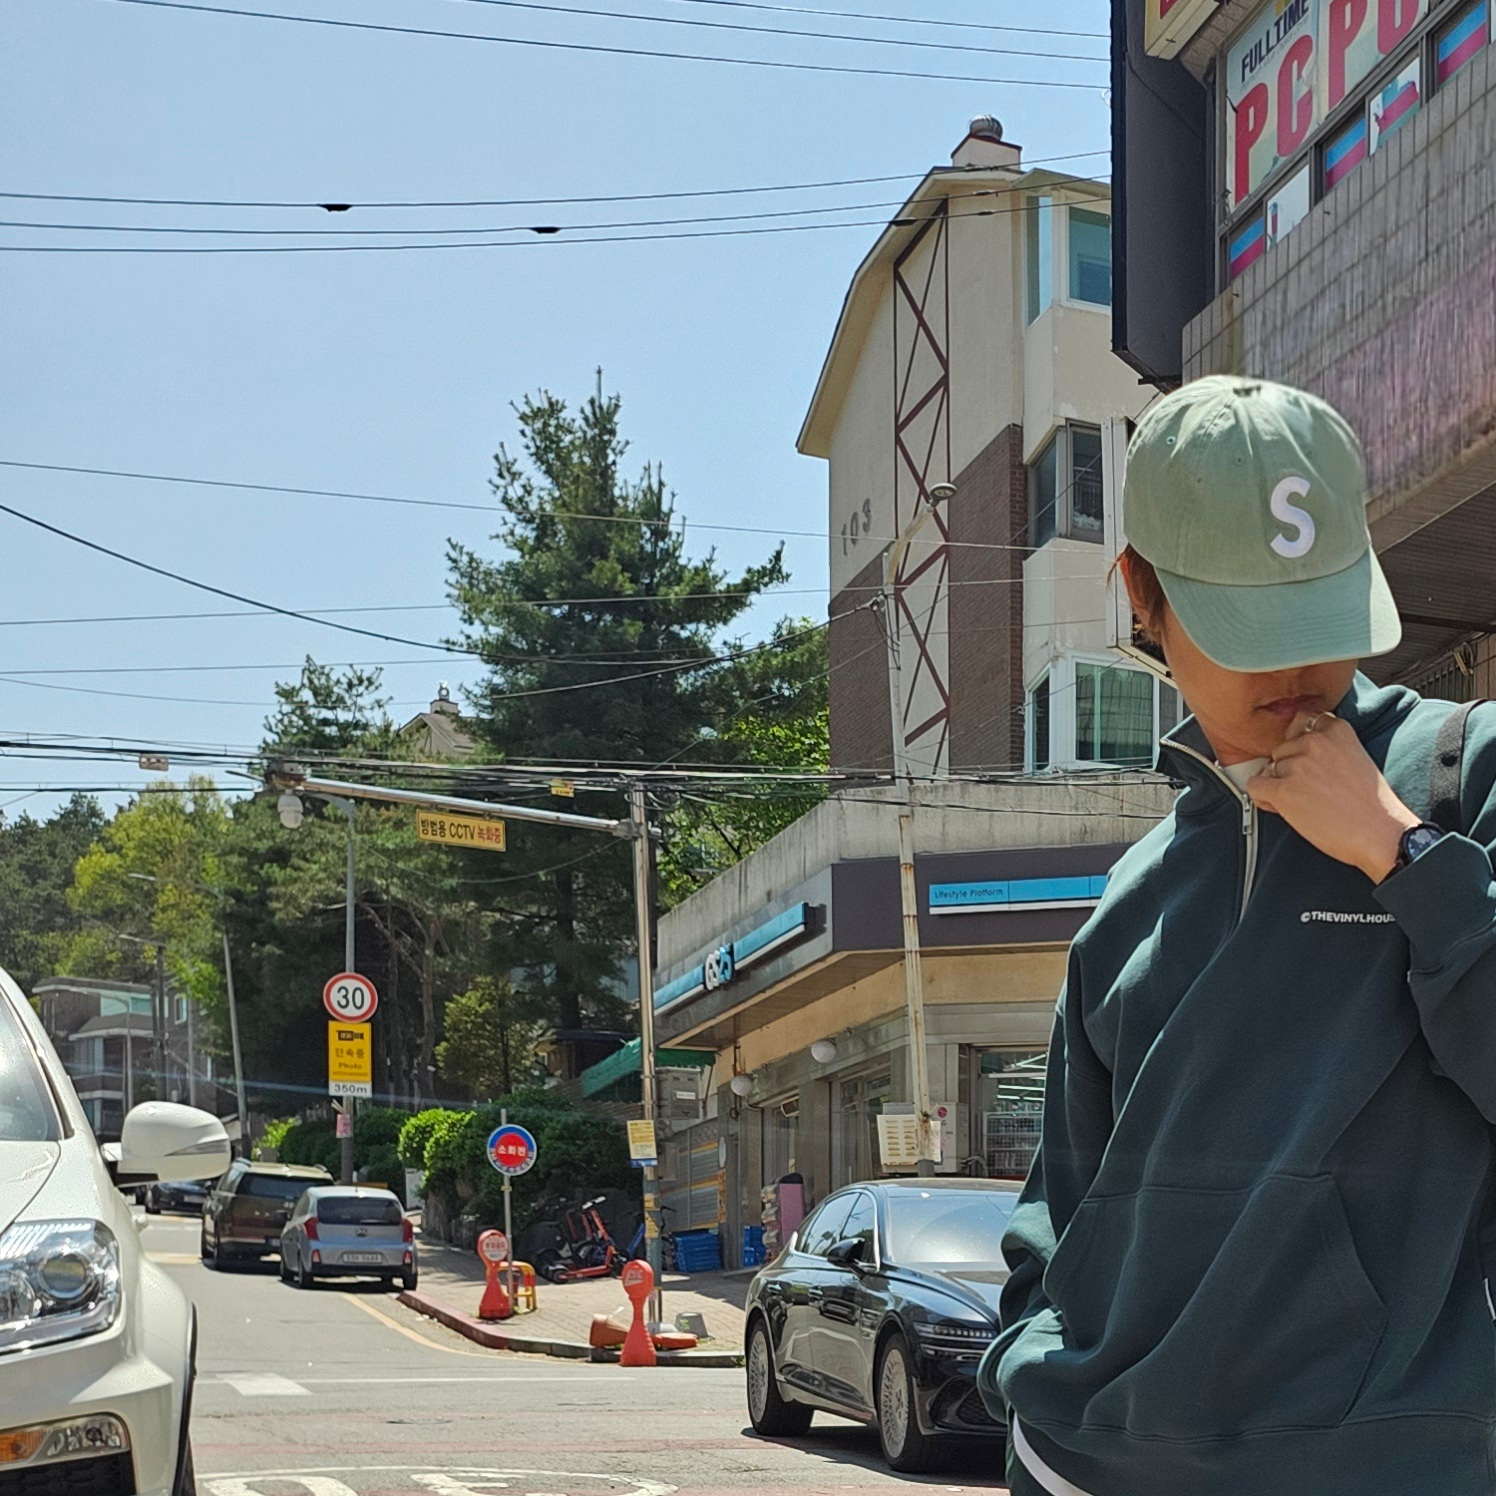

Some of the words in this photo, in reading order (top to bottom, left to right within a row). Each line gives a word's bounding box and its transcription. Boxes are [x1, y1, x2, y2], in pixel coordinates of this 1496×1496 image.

[841, 497, 872, 556] 103
[1270, 475, 1316, 558] S
[421, 818, 447, 838] 방범용
[449, 822, 476, 840] CCTV
[970, 888, 1004, 898] Platform
[336, 985, 365, 1011] 30
[338, 1062, 362, 1070] Photo
[334, 1083, 368, 1095] 350m
